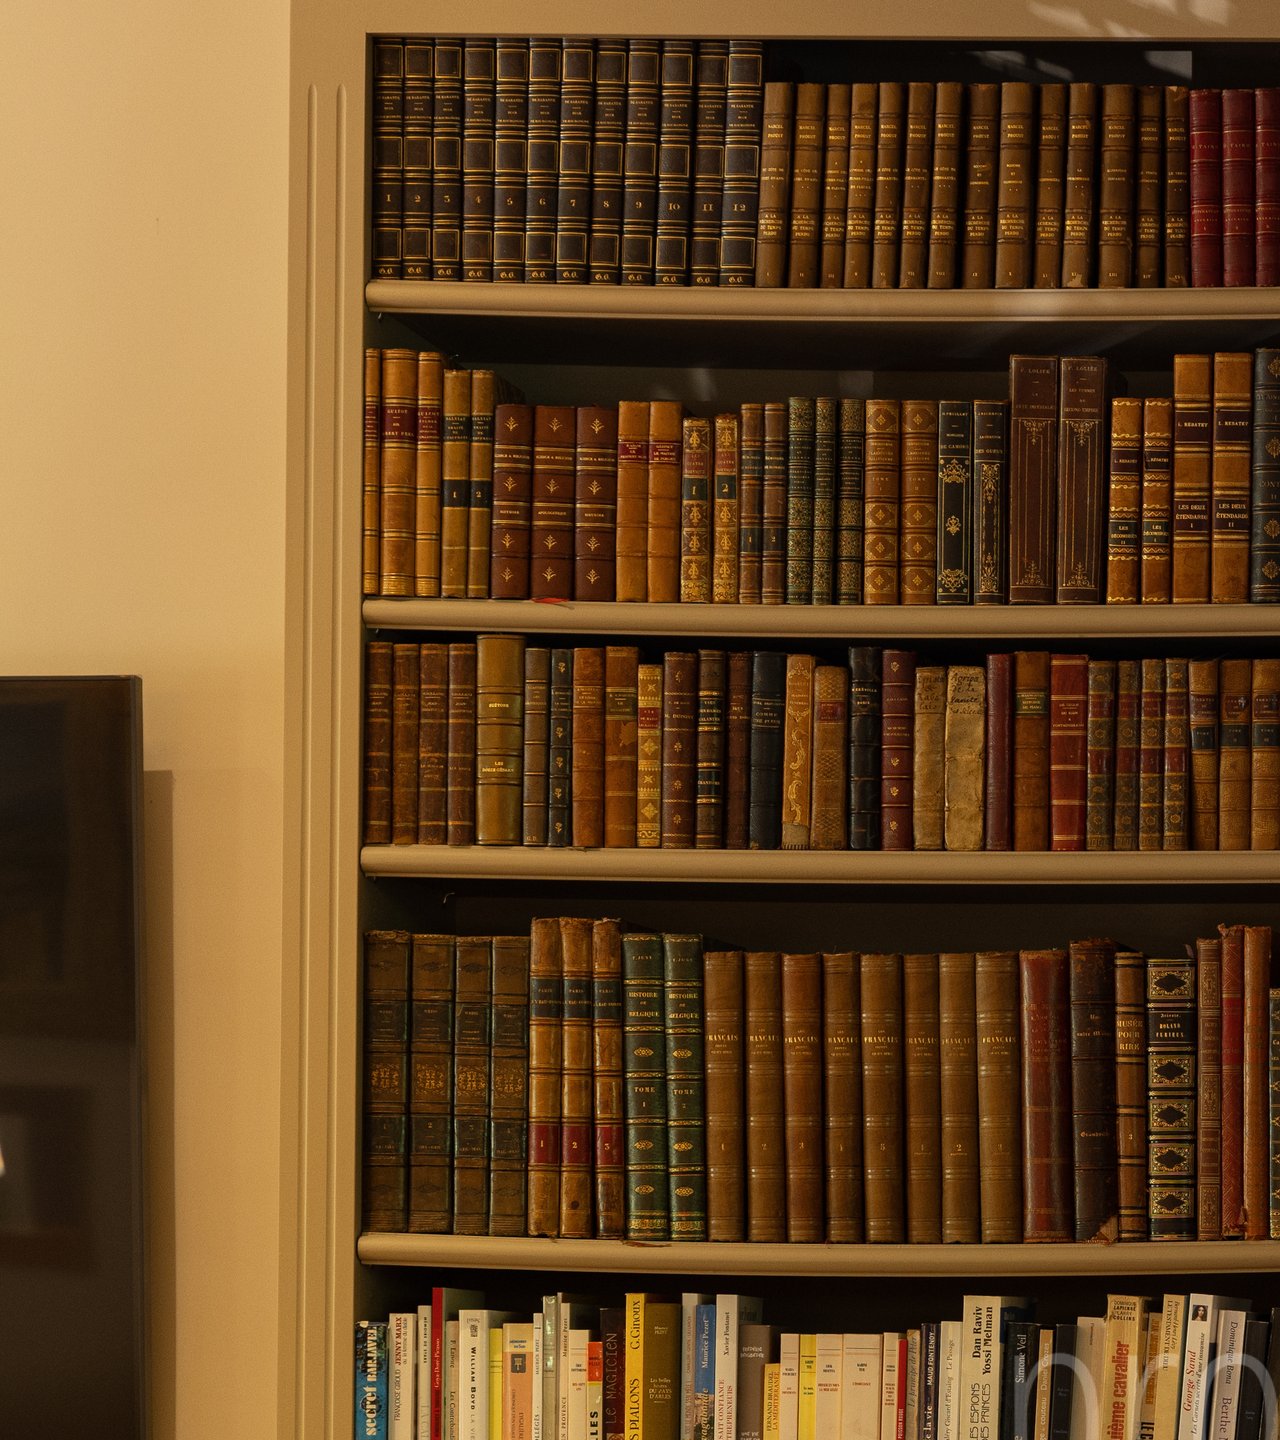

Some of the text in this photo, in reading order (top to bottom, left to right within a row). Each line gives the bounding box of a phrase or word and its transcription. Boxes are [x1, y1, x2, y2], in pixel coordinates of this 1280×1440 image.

[628, 1010, 660, 1018] BELGIQUE
[395, 1317, 403, 1339] MARX
[629, 1300, 641, 1350] G.Ginoux
[972, 1306, 983, 1359] Dan Raviv
[1015, 1334, 1027, 1383] Simone Veil
[1108, 1341, 1129, 1397] cavalier
[361, 1385, 378, 1436] secret
[628, 1378, 640, 1430] PIALONS
[969, 1383, 980, 1424] ESPIONS
[980, 1383, 990, 1423] PRINCES
